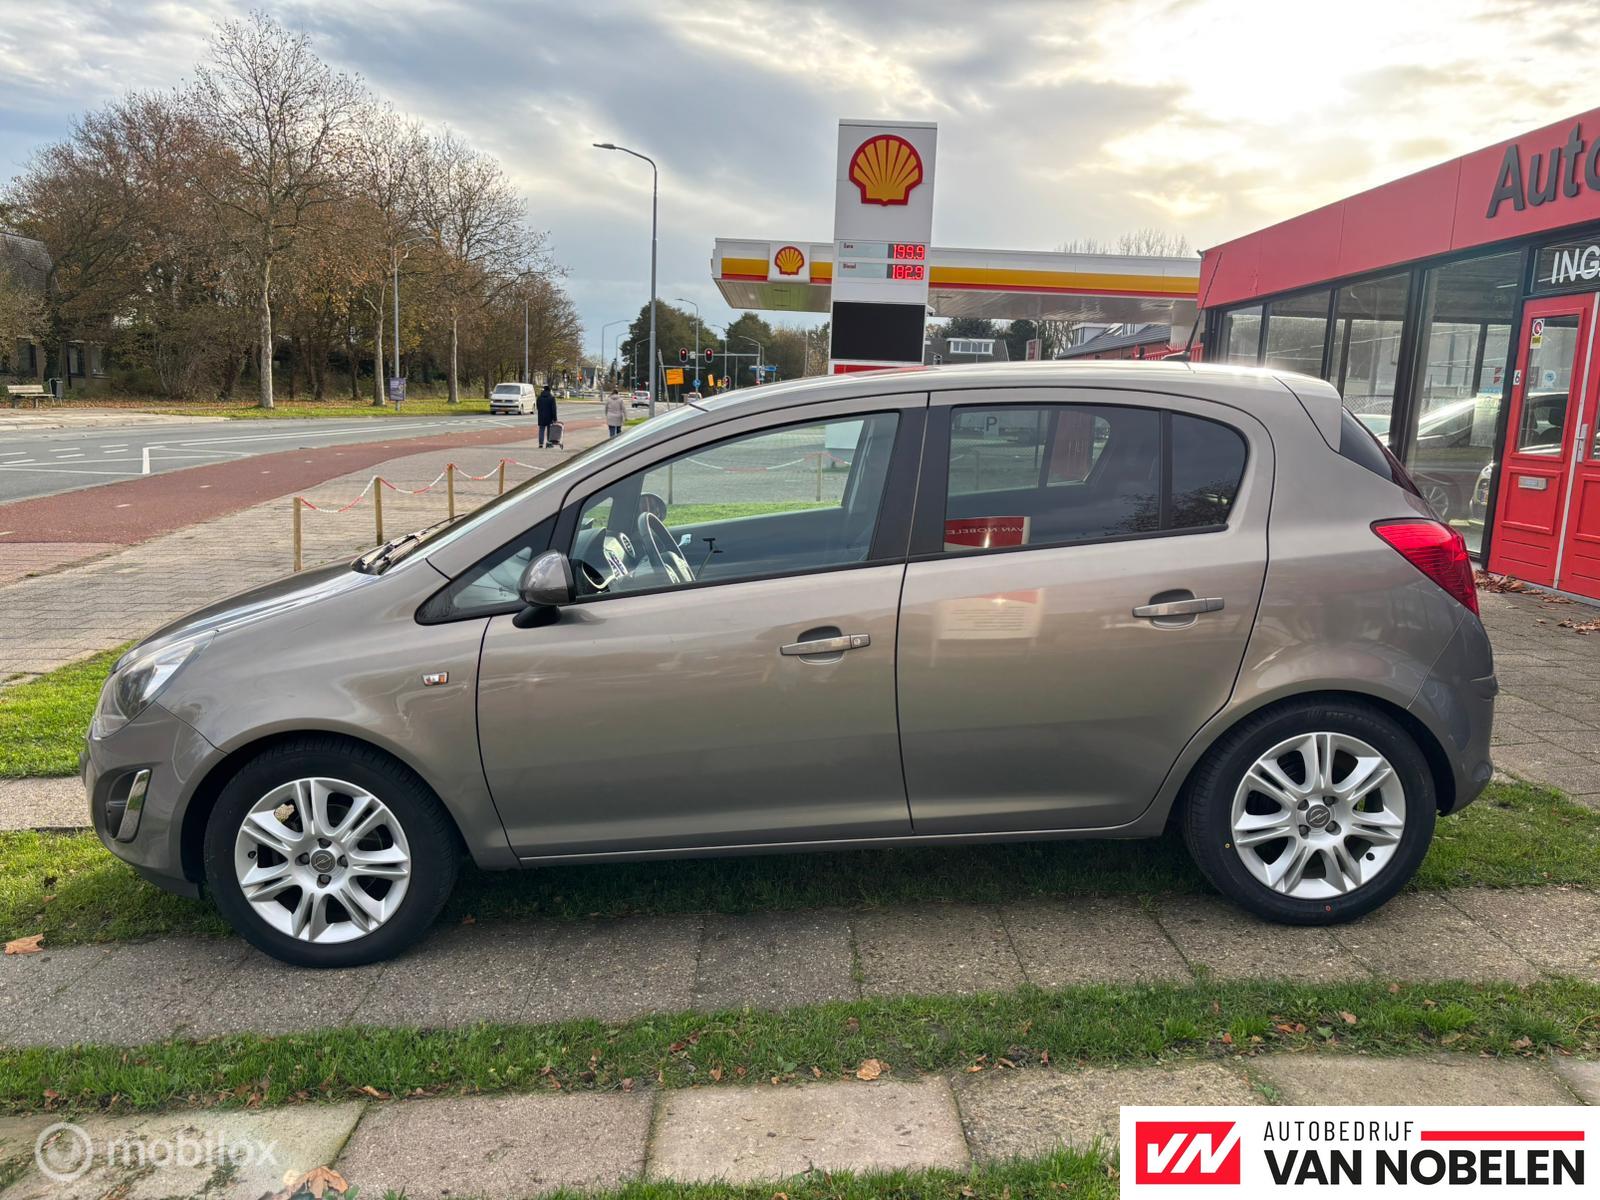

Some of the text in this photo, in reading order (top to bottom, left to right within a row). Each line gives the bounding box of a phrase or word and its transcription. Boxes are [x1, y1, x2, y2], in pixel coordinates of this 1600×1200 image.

[893, 244, 925, 260] 199.9
[1551, 245, 1600, 284] ING
[986, 416, 998, 432] P
